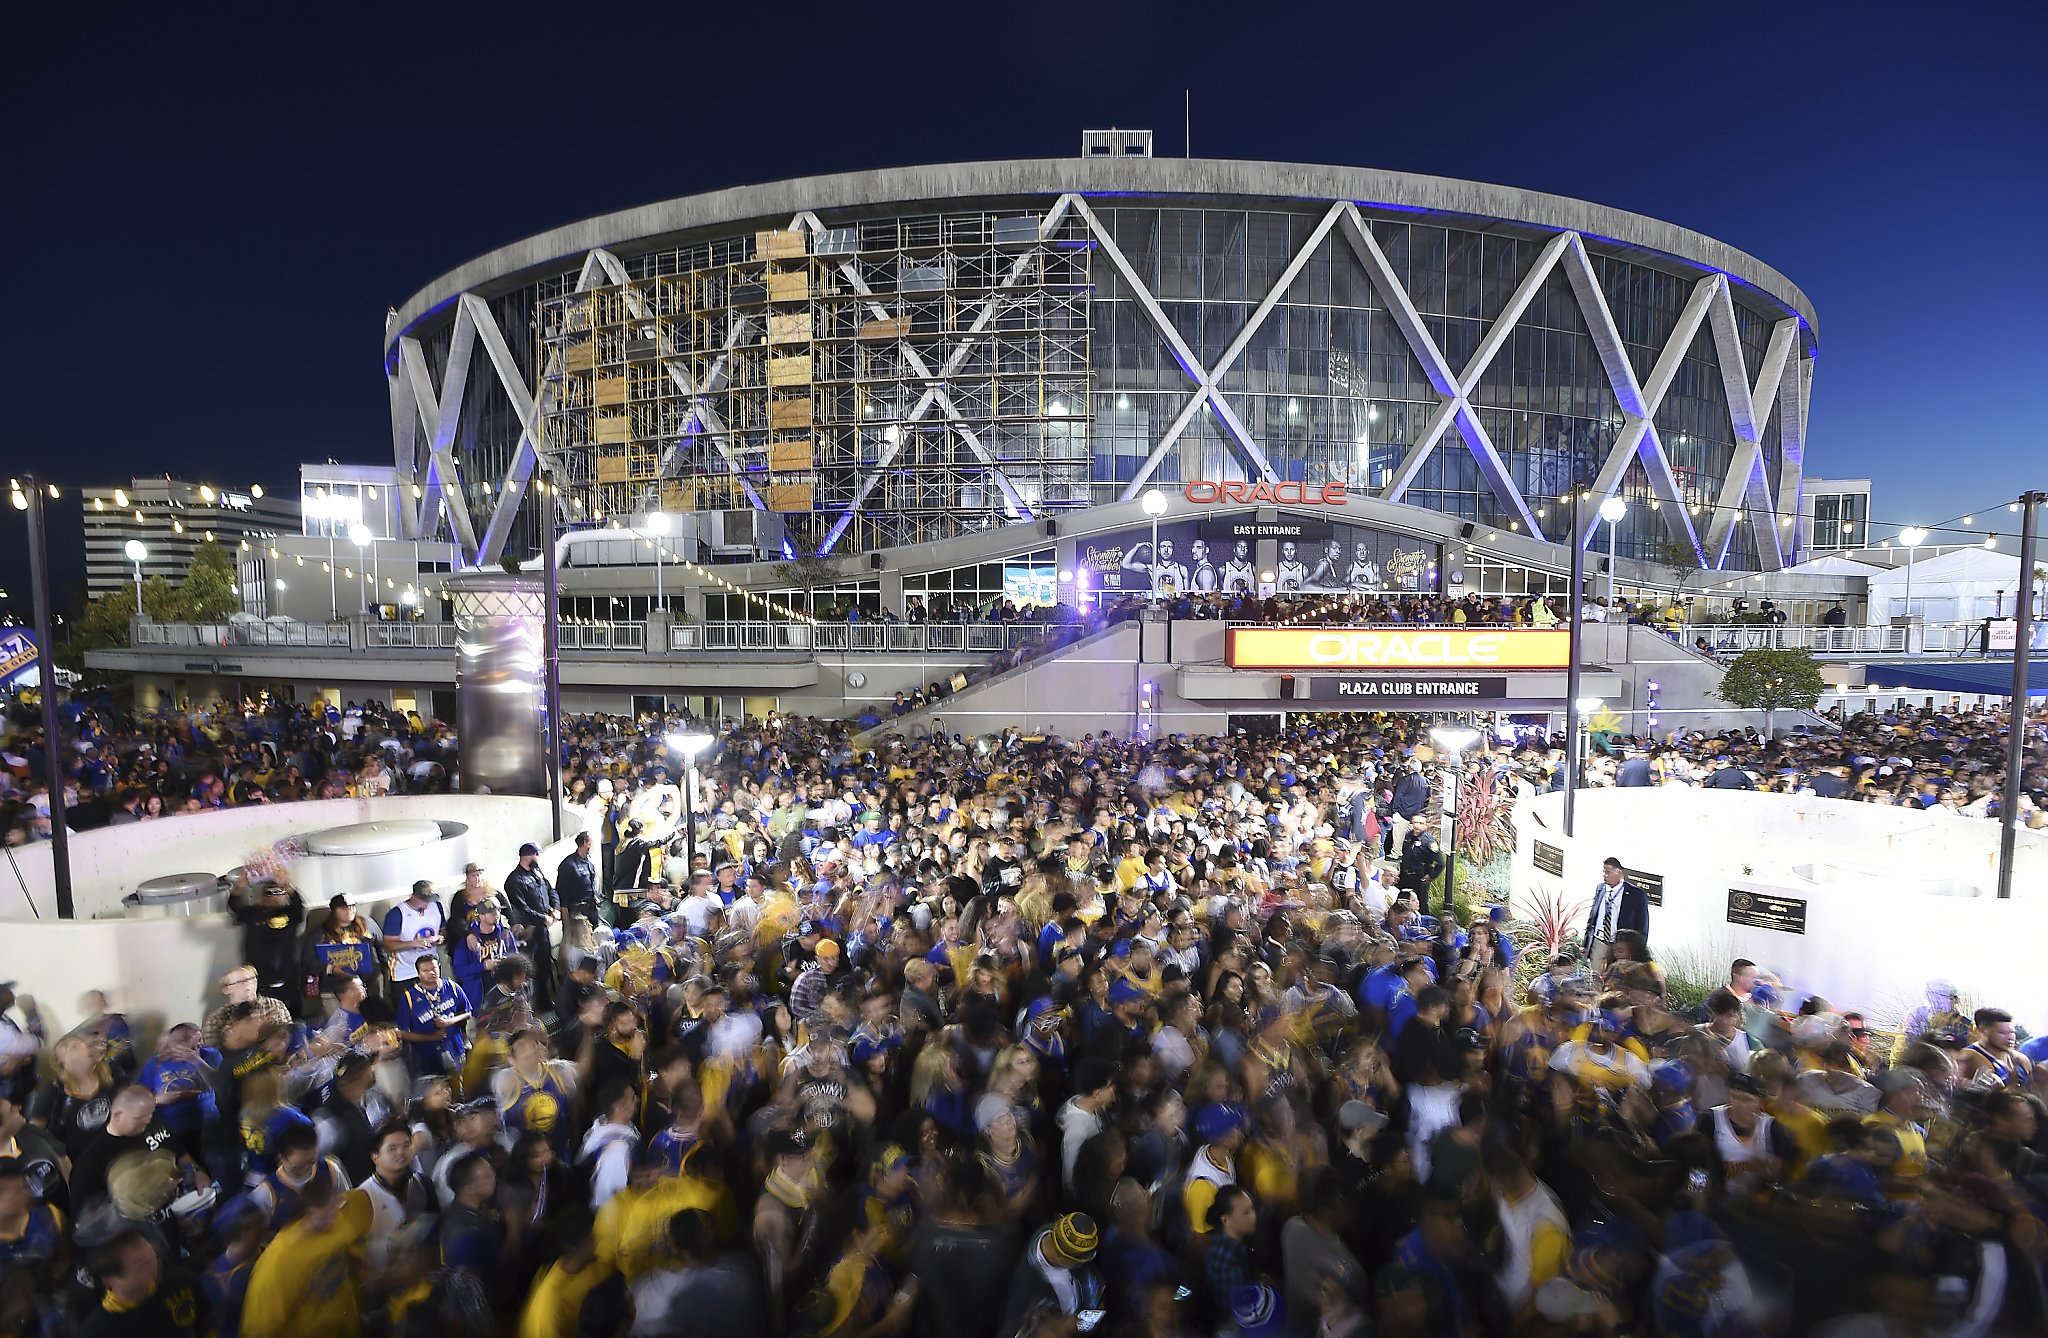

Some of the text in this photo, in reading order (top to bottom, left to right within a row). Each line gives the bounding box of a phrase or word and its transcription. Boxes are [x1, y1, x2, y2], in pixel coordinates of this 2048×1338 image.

[1185, 480, 1348, 505] ORACLE
[1233, 525, 1301, 535] EAST ENTRANCE
[1308, 633, 1499, 663] ORACLE
[1339, 682, 1479, 695] PLAZA CLUB ENTRANCE
